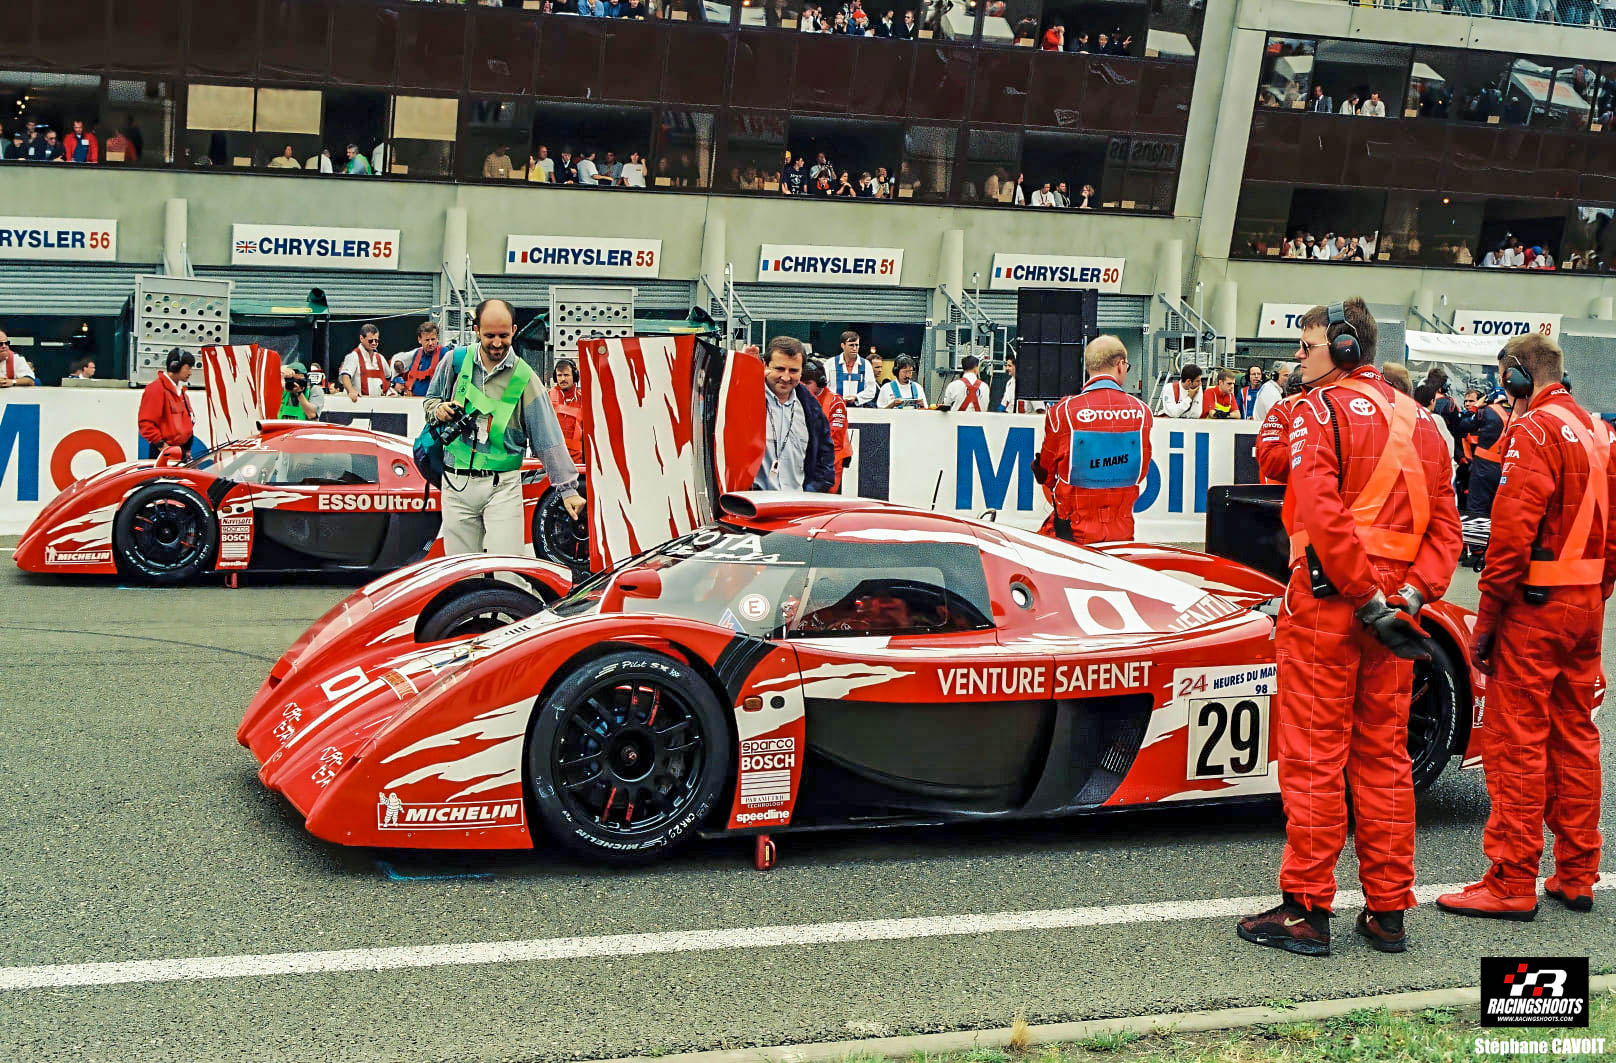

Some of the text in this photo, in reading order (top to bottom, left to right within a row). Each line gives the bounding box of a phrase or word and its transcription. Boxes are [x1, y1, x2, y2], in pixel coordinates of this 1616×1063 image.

[89, 231, 111, 249] 56
[258, 237, 393, 258] CHRYSLER 55
[529, 247, 655, 267] CHRYSLER 53
[780, 256, 895, 275] CHRYSLER 51
[1013, 265, 1119, 284] CHRYSLER 50
[1472, 320, 1552, 337] TOYOTA 28
[1096, 409, 1143, 421] TOYOTA
[956, 425, 1210, 513] Mil
[1090, 454, 1129, 469] LE MANS
[318, 494, 437, 511] ESSO Ultron
[222, 534, 250, 542] BOSCH
[57, 552, 110, 561] MICHELIN
[621, 660, 670, 672] Pilot SX
[937, 661, 1153, 695] VENTURE SAFENET
[1178, 673, 1208, 698] 24
[1213, 673, 1245, 690] HEURES
[1246, 669, 1259, 682] DU
[1255, 684, 1268, 695] 98
[742, 738, 794, 753] sparco
[1195, 700, 1260, 776] 29
[741, 753, 795, 771] BOSCH
[405, 804, 518, 822] MICHELIN
[747, 801, 784, 809] TECHNOLOGY
[736, 809, 790, 823] speedline
[575, 827, 640, 851] MICHELIN
